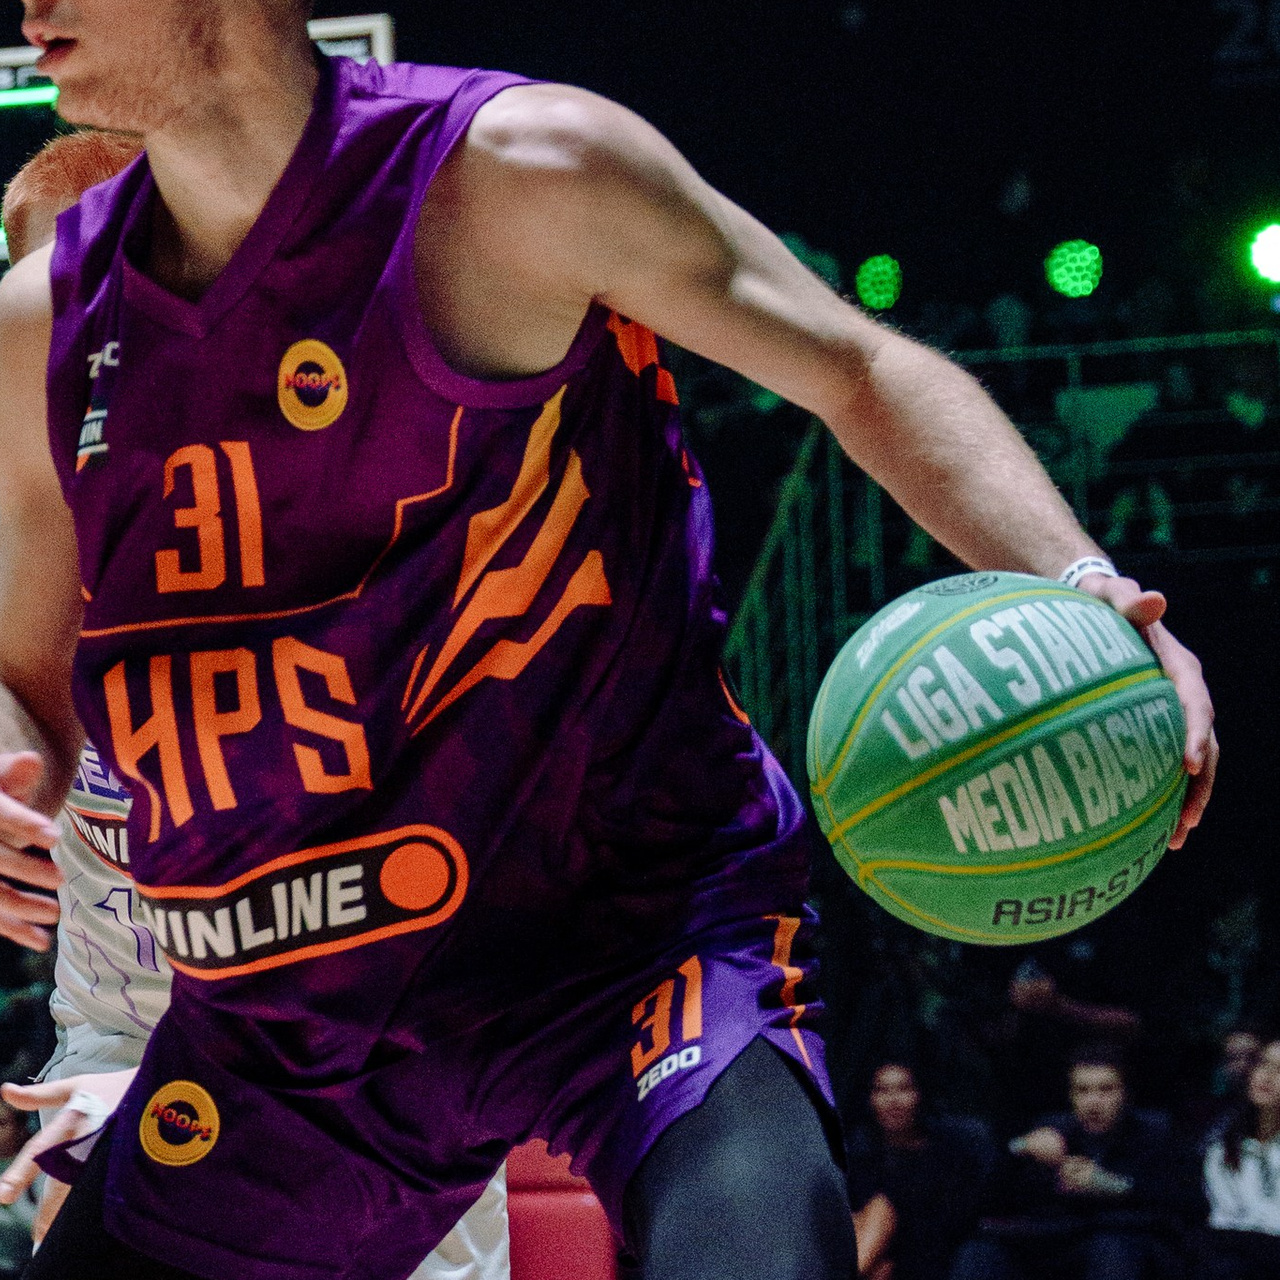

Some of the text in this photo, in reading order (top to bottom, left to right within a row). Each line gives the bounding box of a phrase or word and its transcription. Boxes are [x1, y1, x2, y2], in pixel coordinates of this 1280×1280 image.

[155, 440, 265, 594] 31
[103, 636, 372, 843] HPS
[882, 645, 1003, 760] LIGA
[939, 697, 1182, 855] MEDIA BASKET
[630, 954, 702, 1078] 31
[636, 1045, 702, 1102] ZEDO
